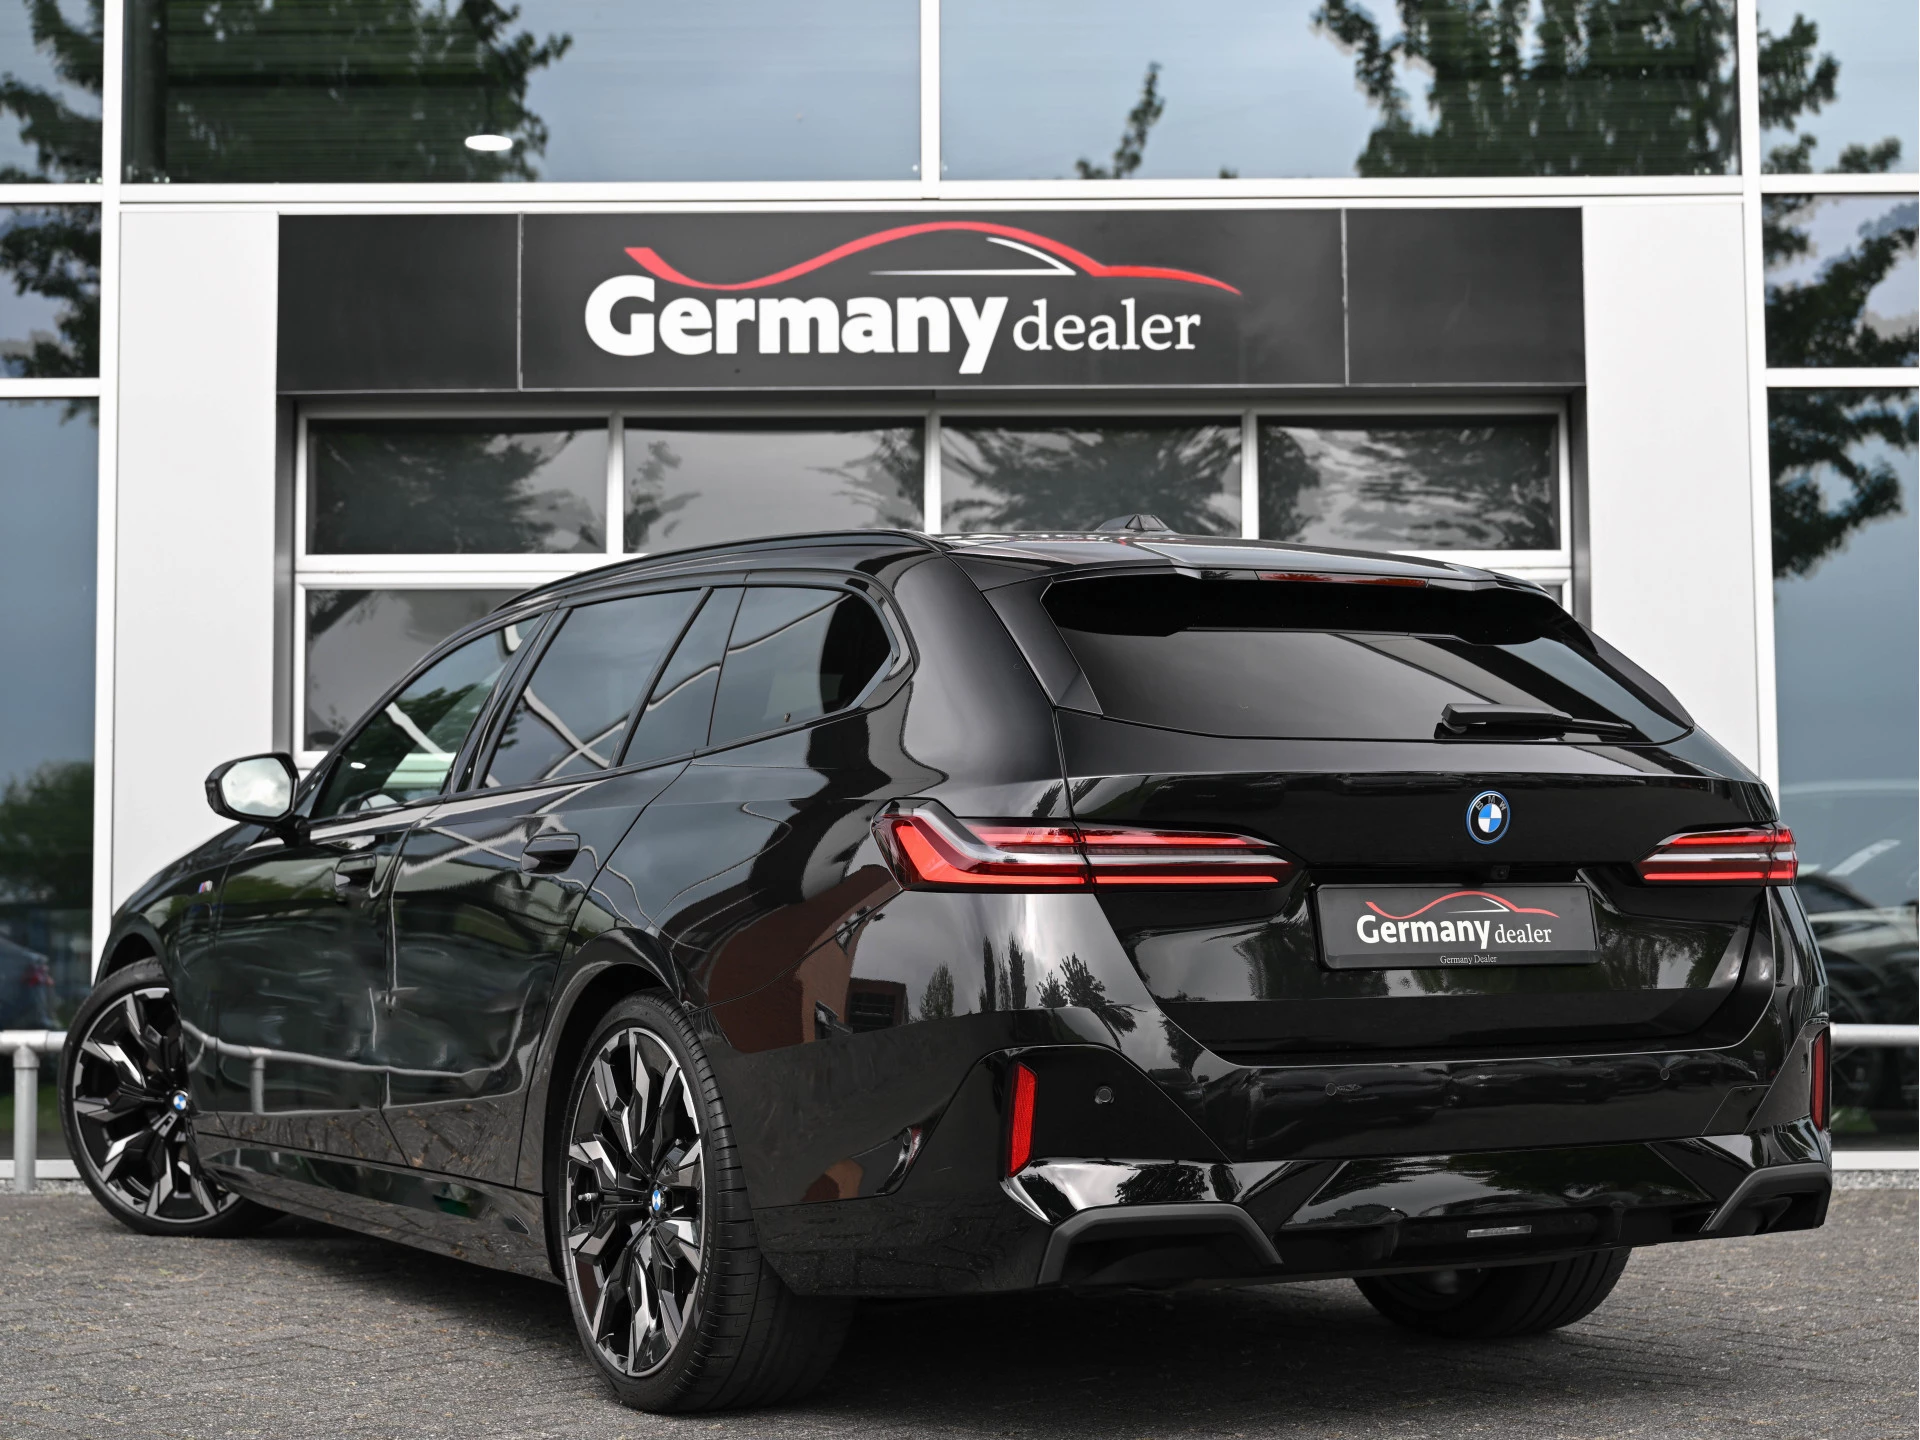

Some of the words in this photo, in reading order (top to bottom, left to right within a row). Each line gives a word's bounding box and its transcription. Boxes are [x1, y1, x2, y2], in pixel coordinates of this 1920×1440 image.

[585, 275, 1009, 375] Germany
[1012, 297, 1201, 351] dealer
[1356, 914, 1491, 950] Germany
[1494, 923, 1552, 944] dealer
[1440, 955, 1472, 965] Germany
[1474, 954, 1498, 964] Dealer
